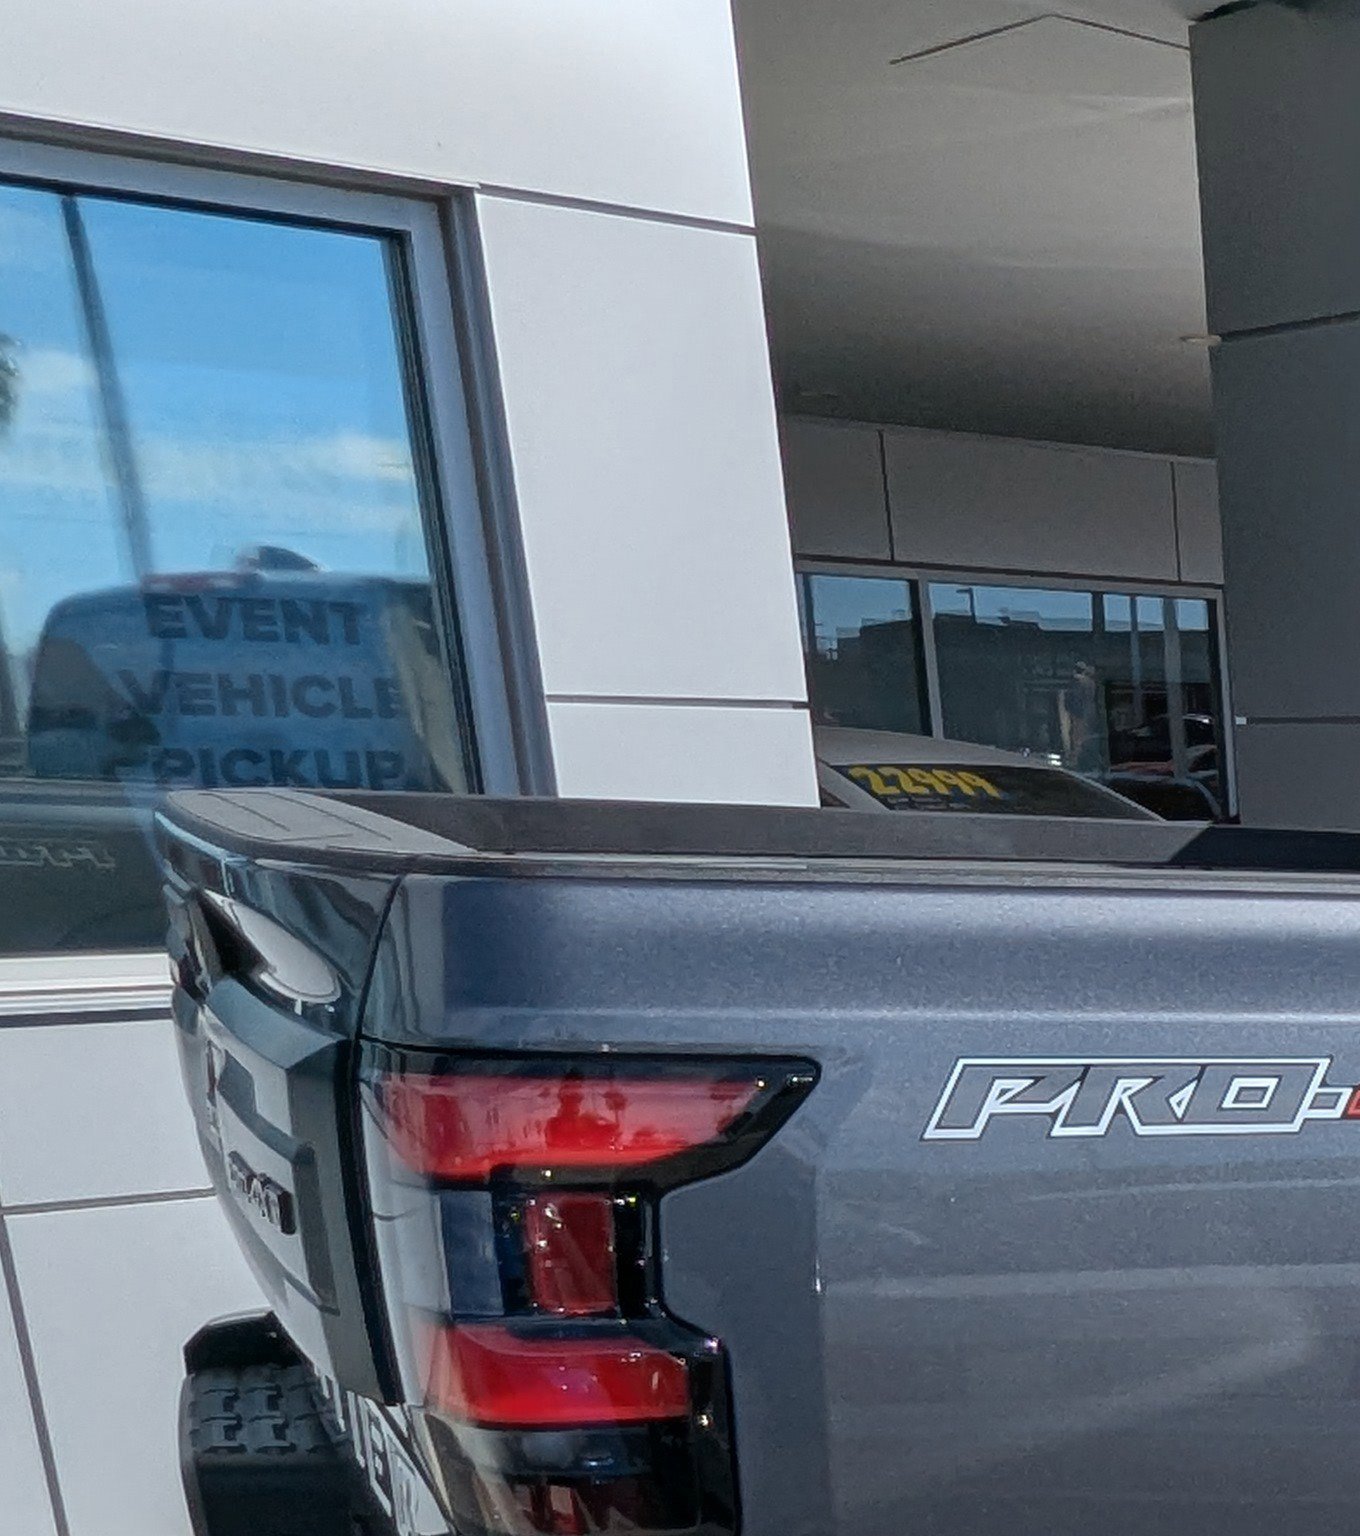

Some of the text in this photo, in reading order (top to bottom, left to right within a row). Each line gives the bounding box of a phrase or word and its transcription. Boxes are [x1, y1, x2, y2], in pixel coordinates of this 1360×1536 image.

[144, 596, 360, 644] EVENT
[118, 669, 402, 719] VEHICLE
[150, 747, 402, 788] PICKUP
[848, 765, 1000, 798] 22999
